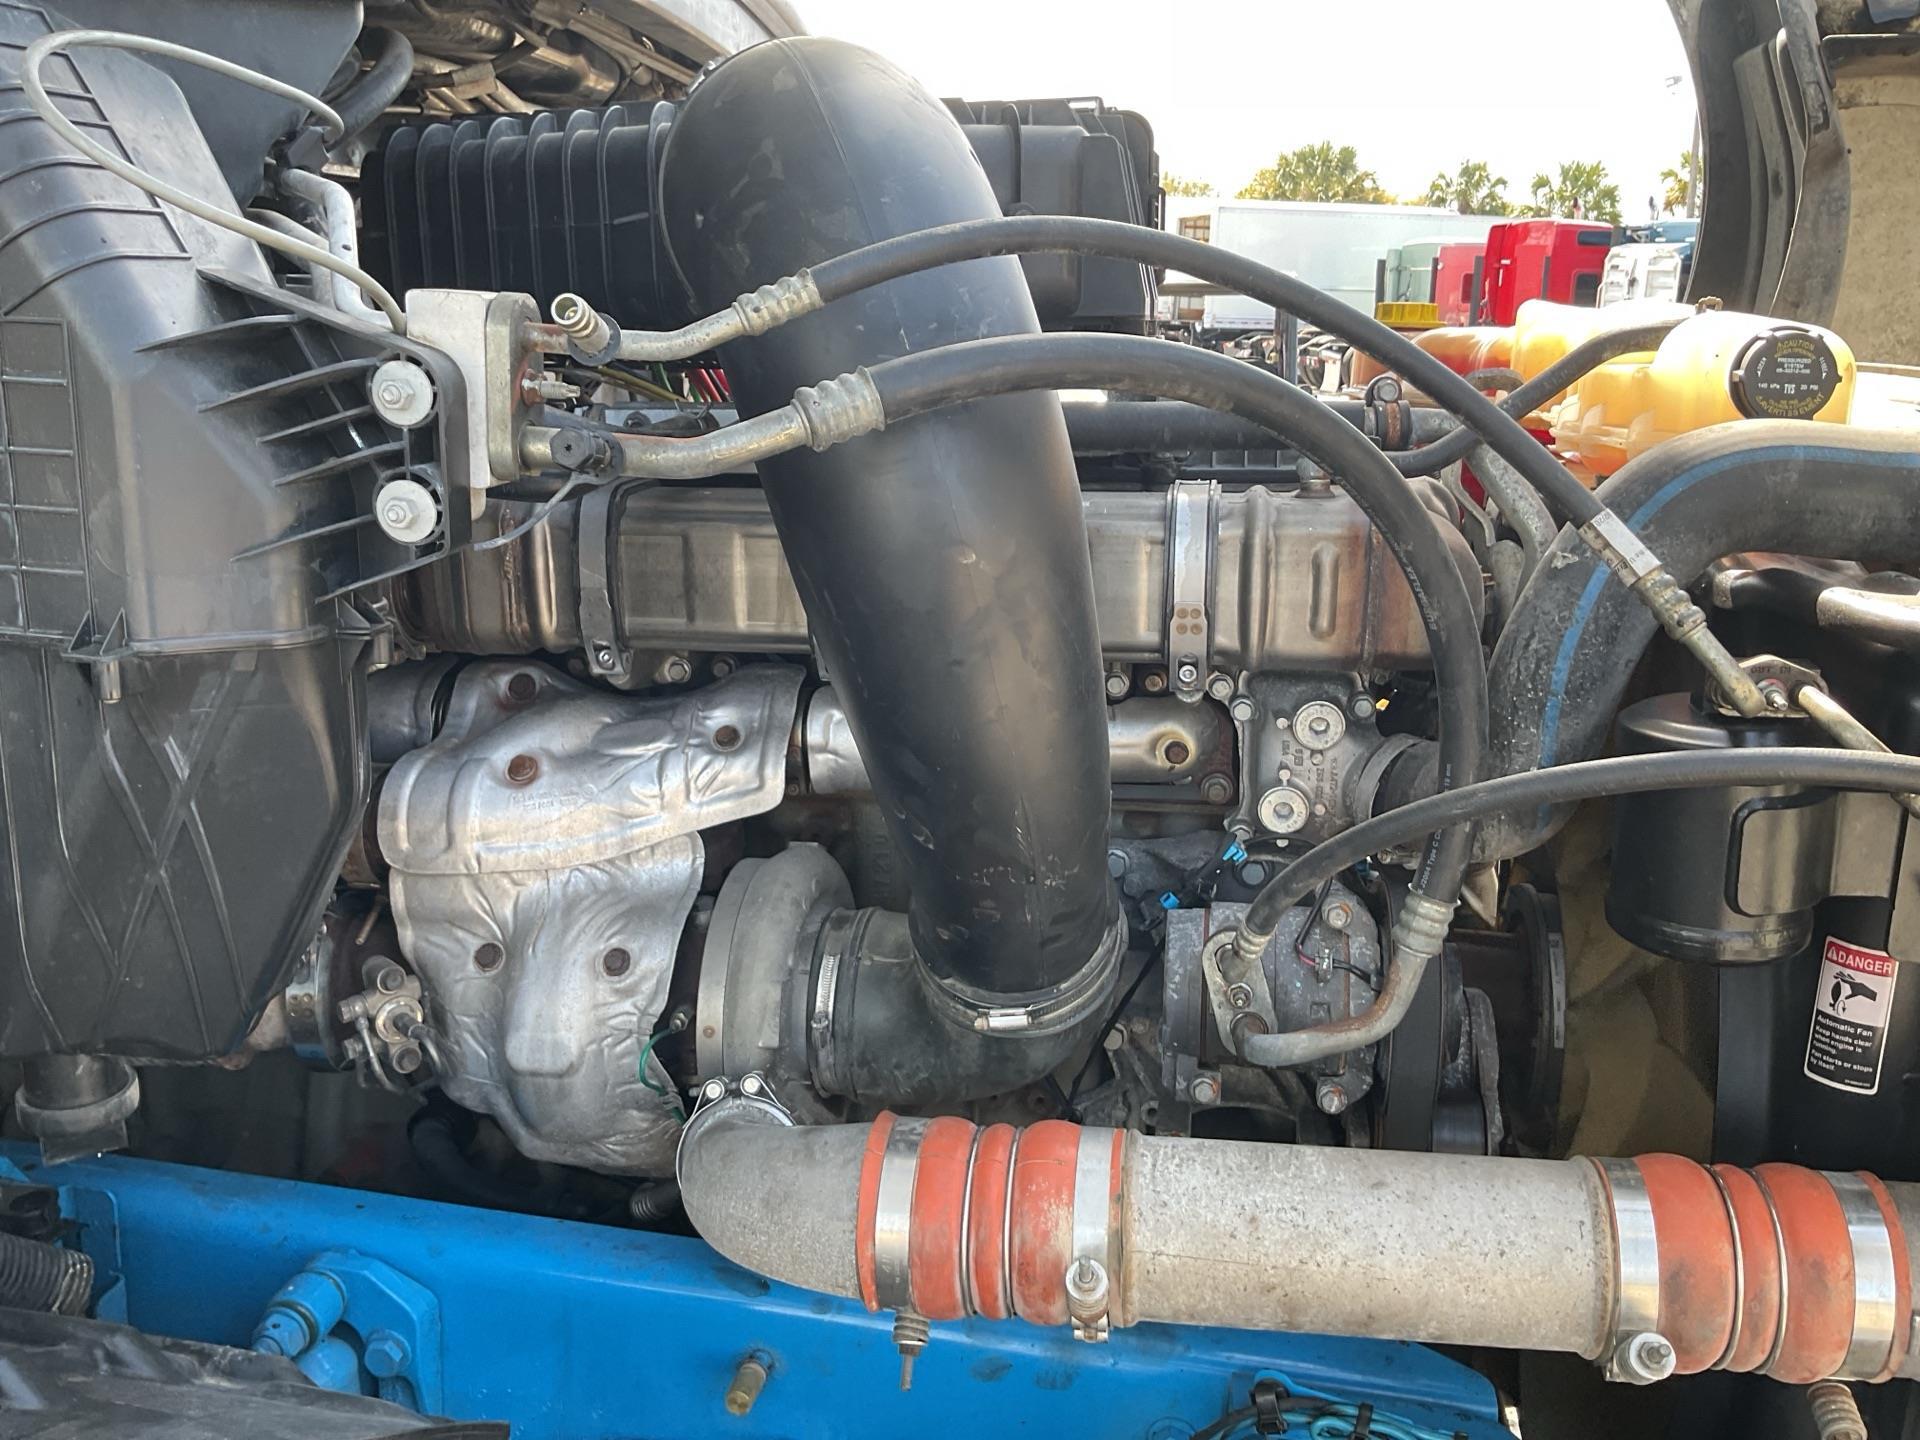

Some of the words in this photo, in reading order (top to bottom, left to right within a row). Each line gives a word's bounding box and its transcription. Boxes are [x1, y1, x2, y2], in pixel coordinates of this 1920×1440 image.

[1782, 340, 1815, 351] CAUTION
[1838, 950, 1892, 975] DANGER
[1815, 1025, 1831, 1036] Keep
[1831, 1032, 1852, 1043] hands
[1853, 1039, 1873, 1047] clear
[1817, 1014, 1855, 1034] Automatic
[1857, 1028, 1873, 1037] Fan
[1814, 1033, 1830, 1043] when
[1830, 1041, 1854, 1051] engine
[1810, 1056, 1818, 1065] by
[1811, 1049, 1822, 1058] Fan
[1822, 1055, 1842, 1066] starts
[1852, 1064, 1873, 1073] stops
